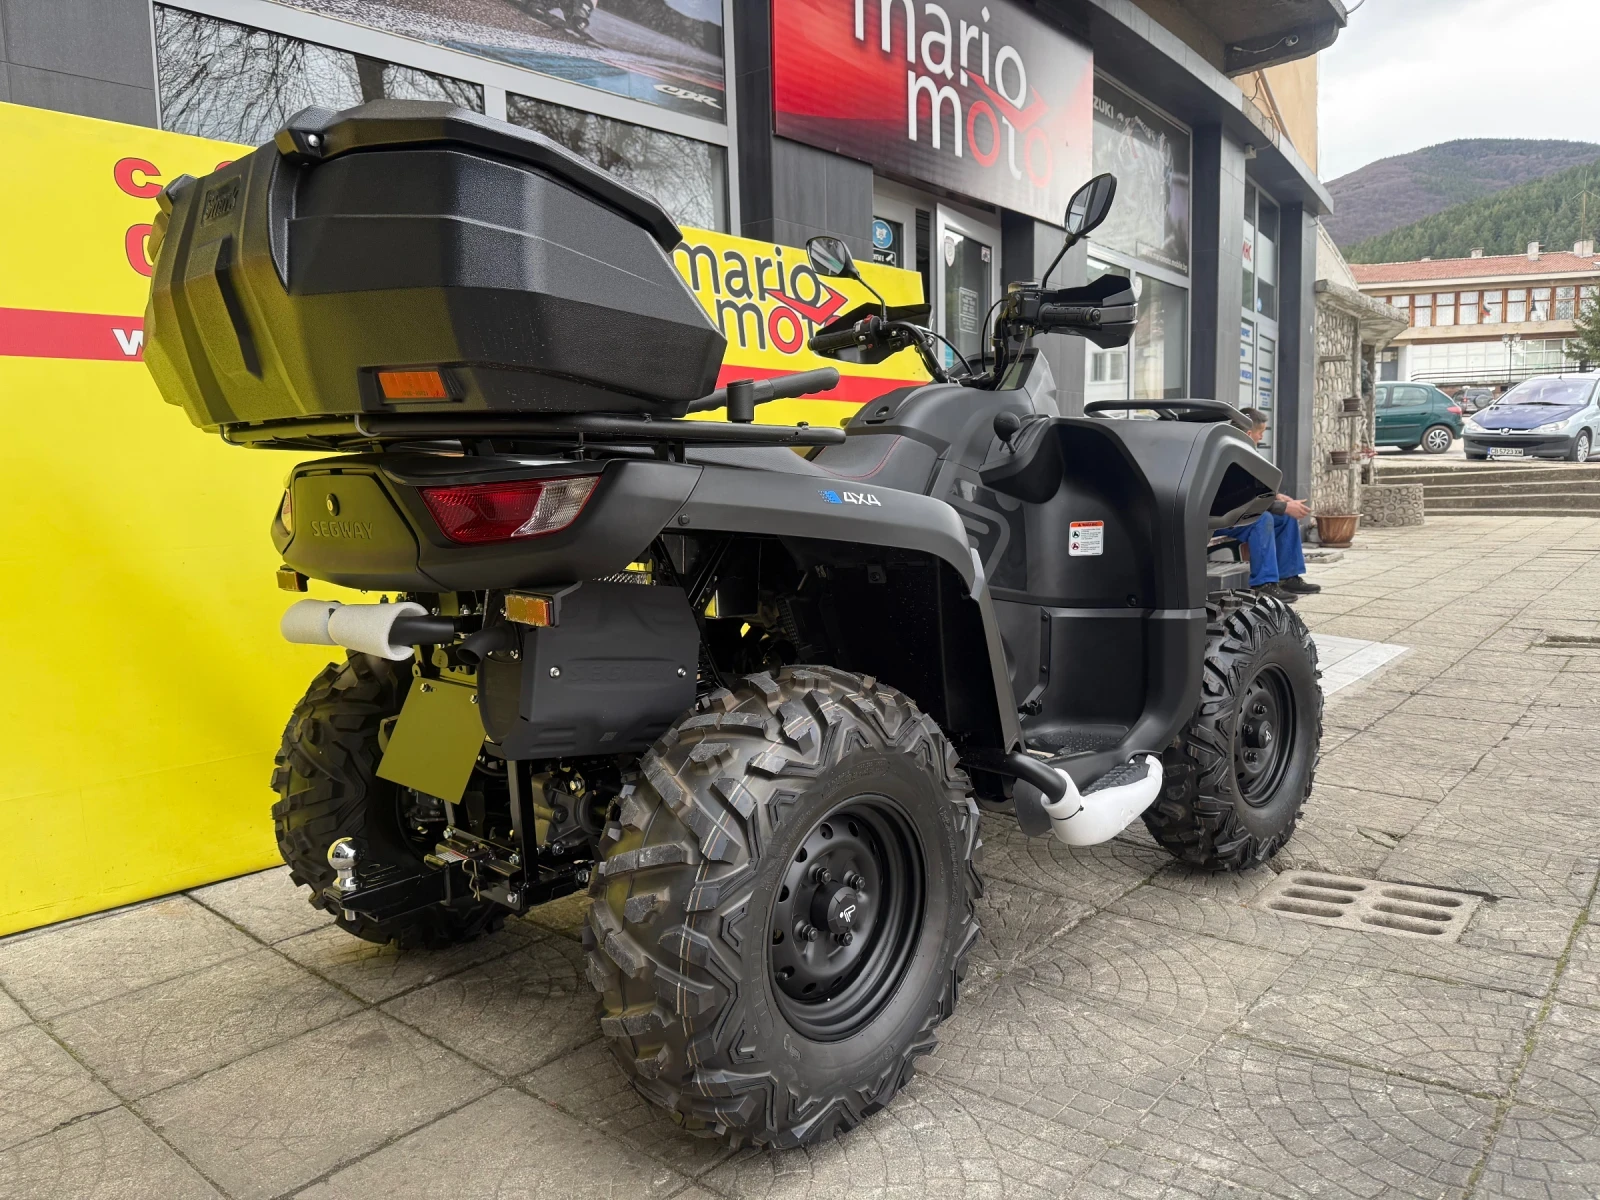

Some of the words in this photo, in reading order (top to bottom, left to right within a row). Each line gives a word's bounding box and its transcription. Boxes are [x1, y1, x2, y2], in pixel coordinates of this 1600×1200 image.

[855, 0, 1027, 110] mario
[908, 69, 1055, 189] moto
[311, 520, 373, 540] SEGWAY
